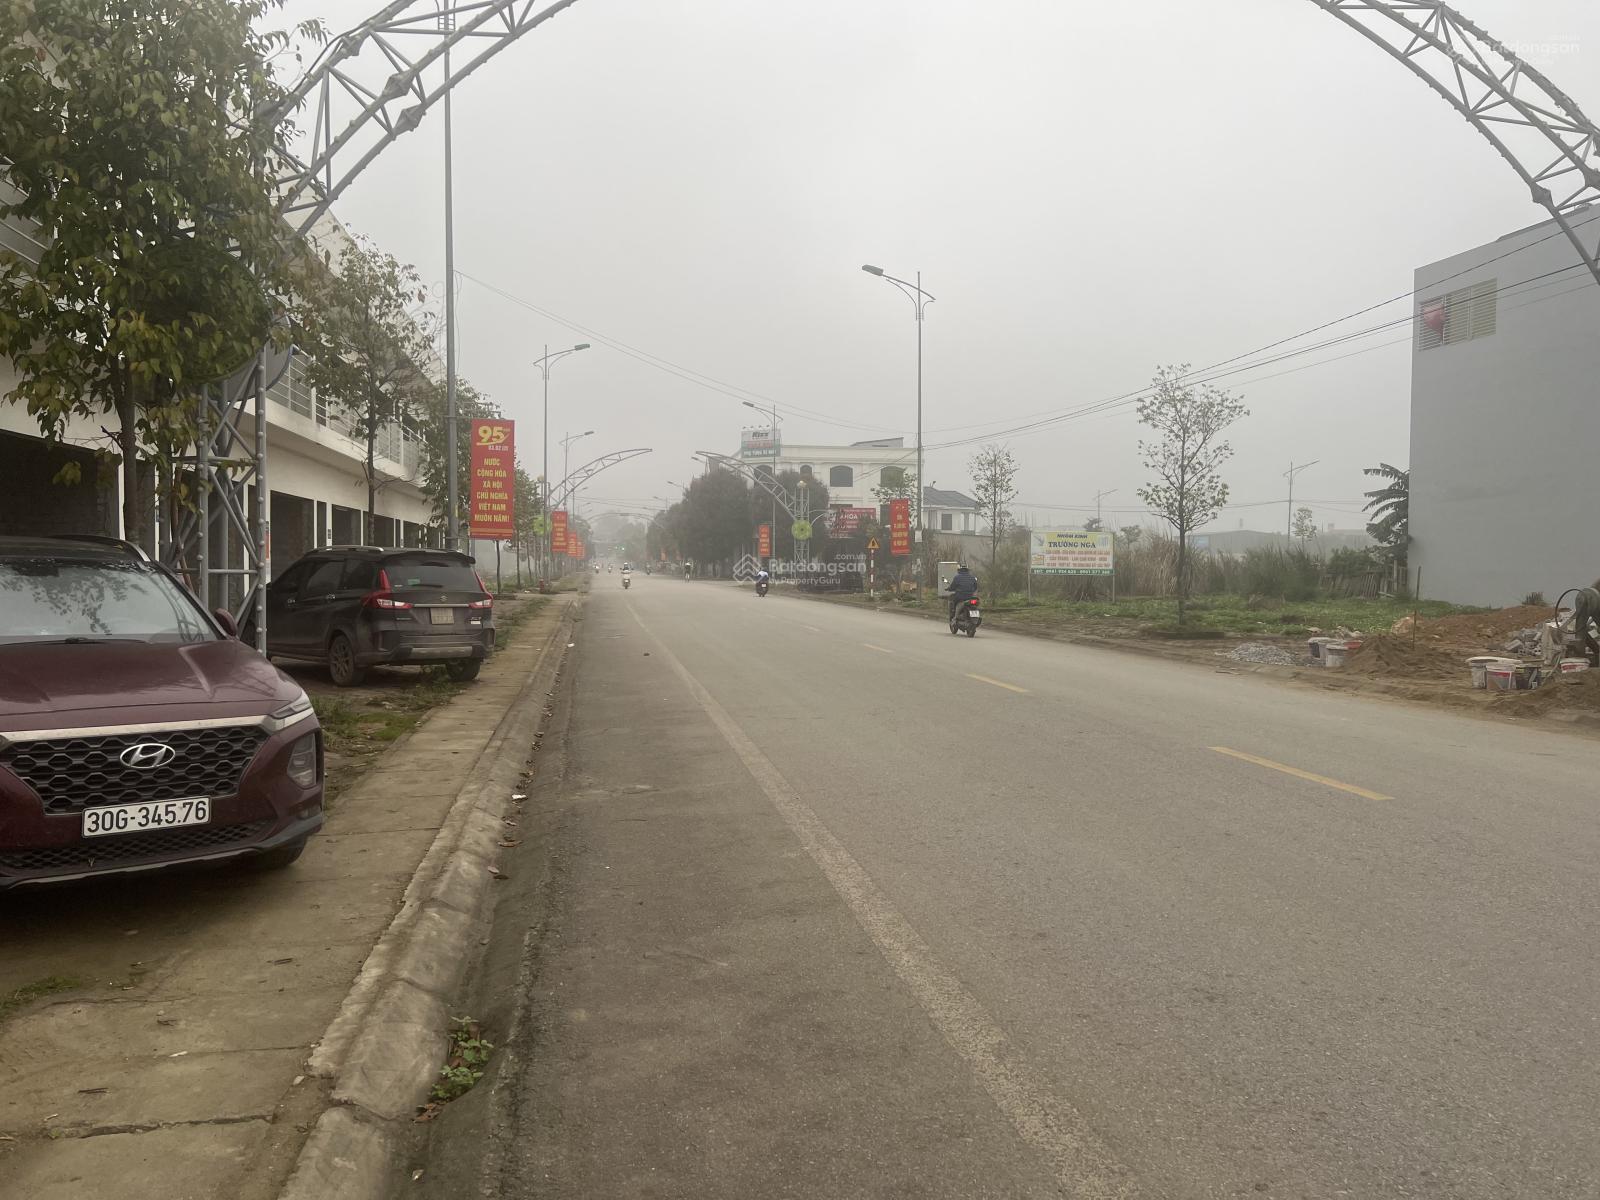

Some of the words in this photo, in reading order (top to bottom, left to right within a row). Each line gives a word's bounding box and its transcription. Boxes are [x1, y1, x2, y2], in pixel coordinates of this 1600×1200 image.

[478, 425, 504, 443] 95
[476, 468, 493, 477] CỘNG
[492, 480, 503, 489] HỘI
[492, 503, 506, 511] NAM
[87, 801, 207, 833] 30G-345.76
